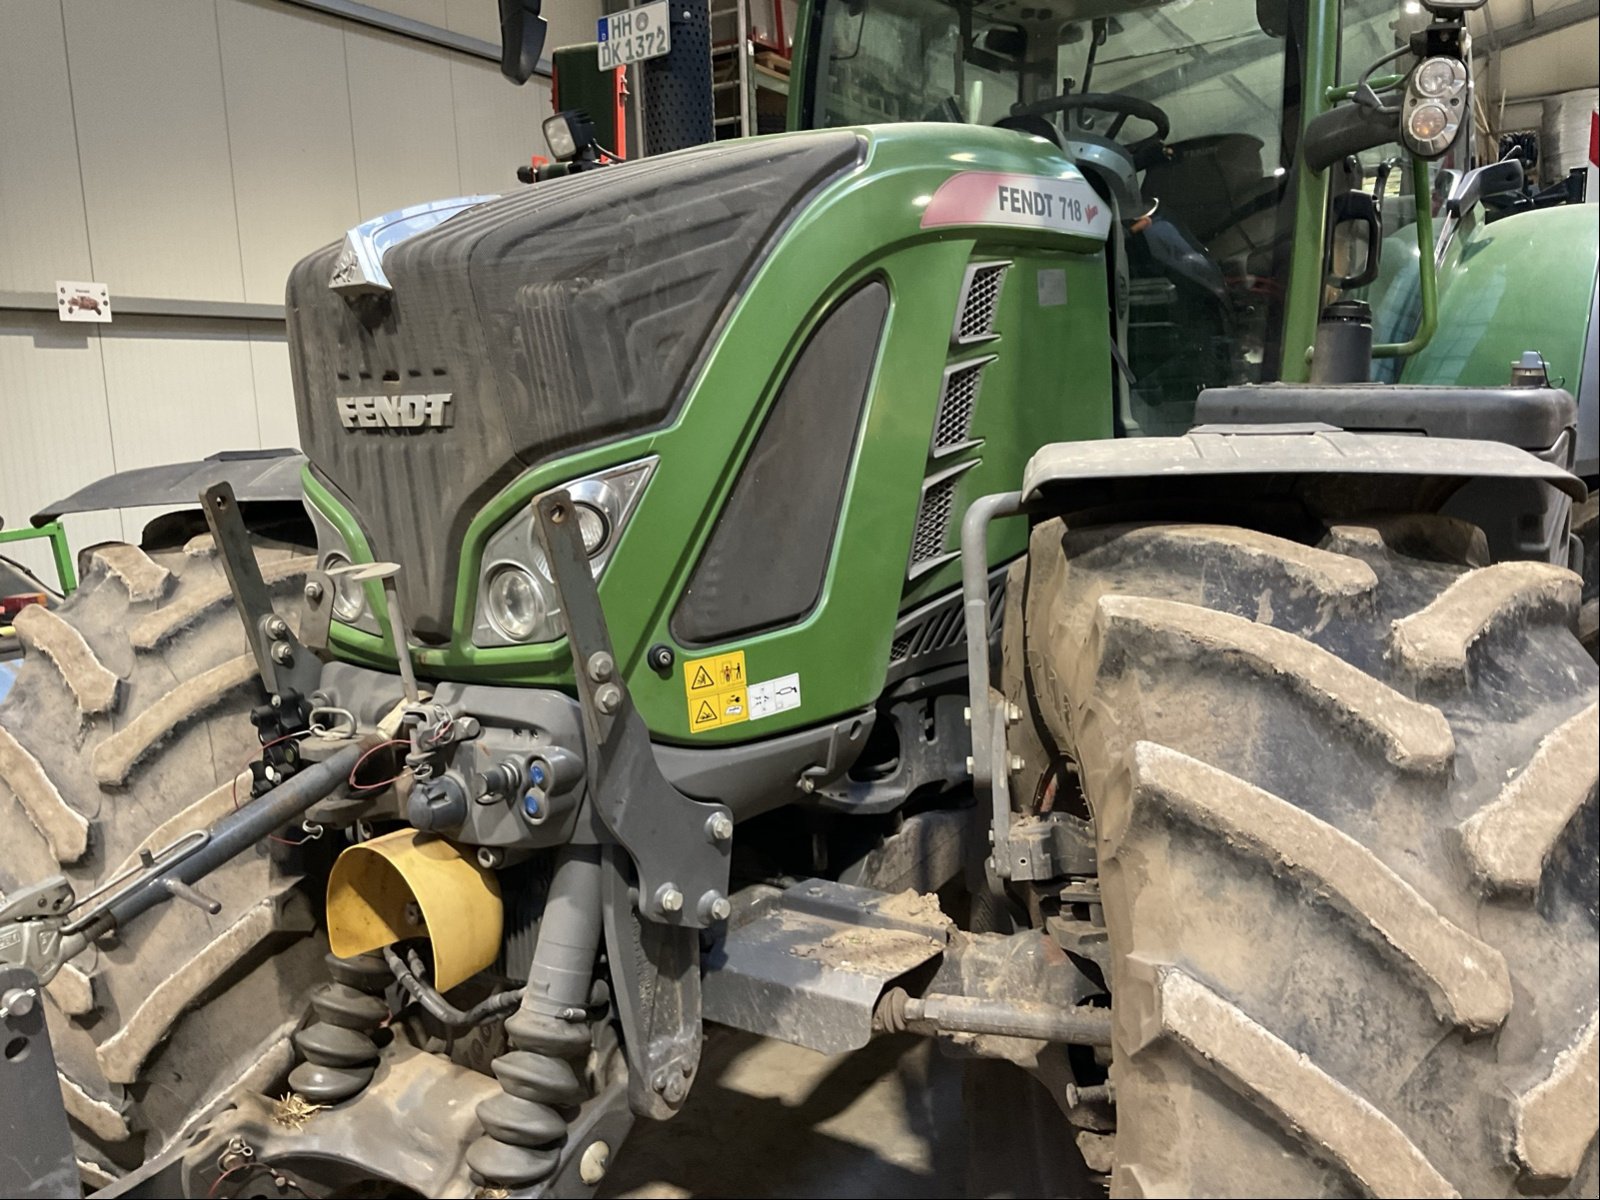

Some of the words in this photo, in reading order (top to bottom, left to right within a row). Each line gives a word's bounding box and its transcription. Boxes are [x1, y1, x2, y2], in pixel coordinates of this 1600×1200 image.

[611, 13, 632, 39] HH
[602, 41, 621, 67] DK
[625, 29, 666, 61] 1372
[998, 185, 1053, 217] FENDT
[1059, 196, 1082, 222] 718
[336, 393, 453, 428] FENDT
